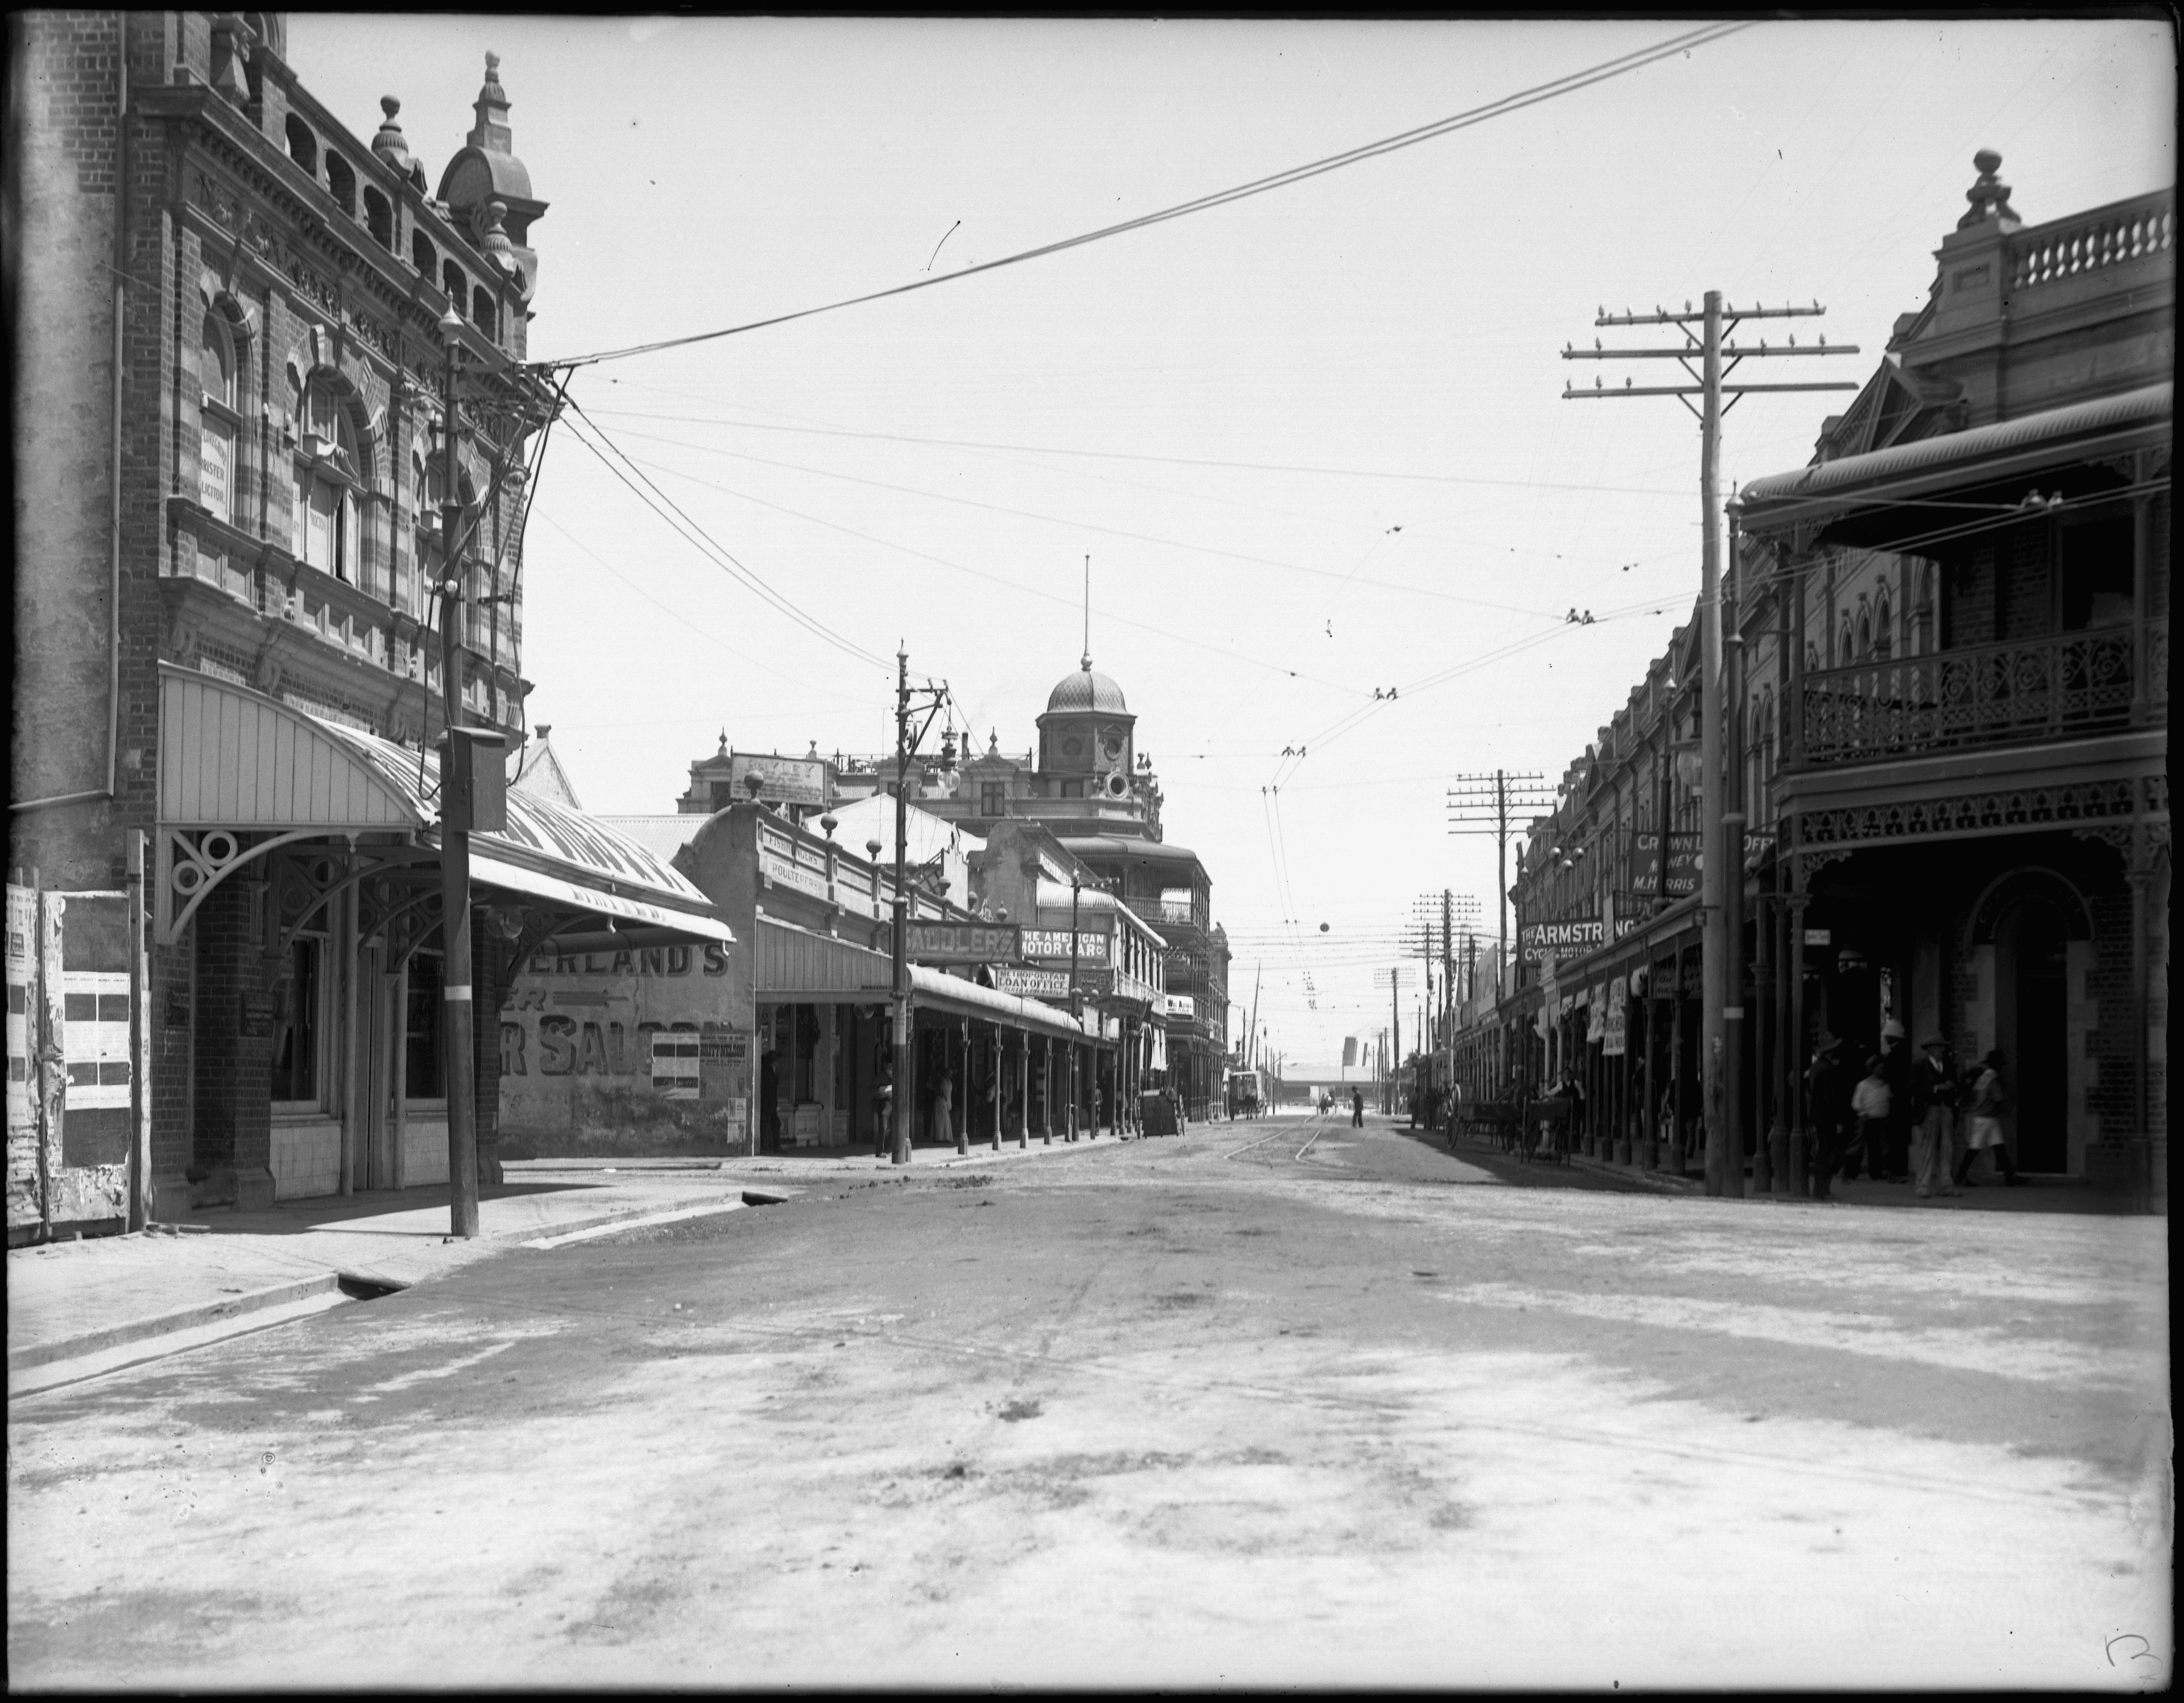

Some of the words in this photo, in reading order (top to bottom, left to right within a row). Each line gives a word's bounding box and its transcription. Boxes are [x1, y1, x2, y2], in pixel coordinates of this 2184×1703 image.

[769, 833, 817, 865] FISHMNGERS
[1637, 834, 1693, 851] CRWN
[1648, 853, 1695, 874] MNEY
[906, 927, 1015, 953] ADDLERS
[1021, 930, 1041, 941] HE
[1521, 928, 1536, 944] THE
[1534, 919, 1635, 945] ARMSTRNG
[528, 942, 729, 977] ERLAND'S
[999, 977, 1027, 987] LOAN
